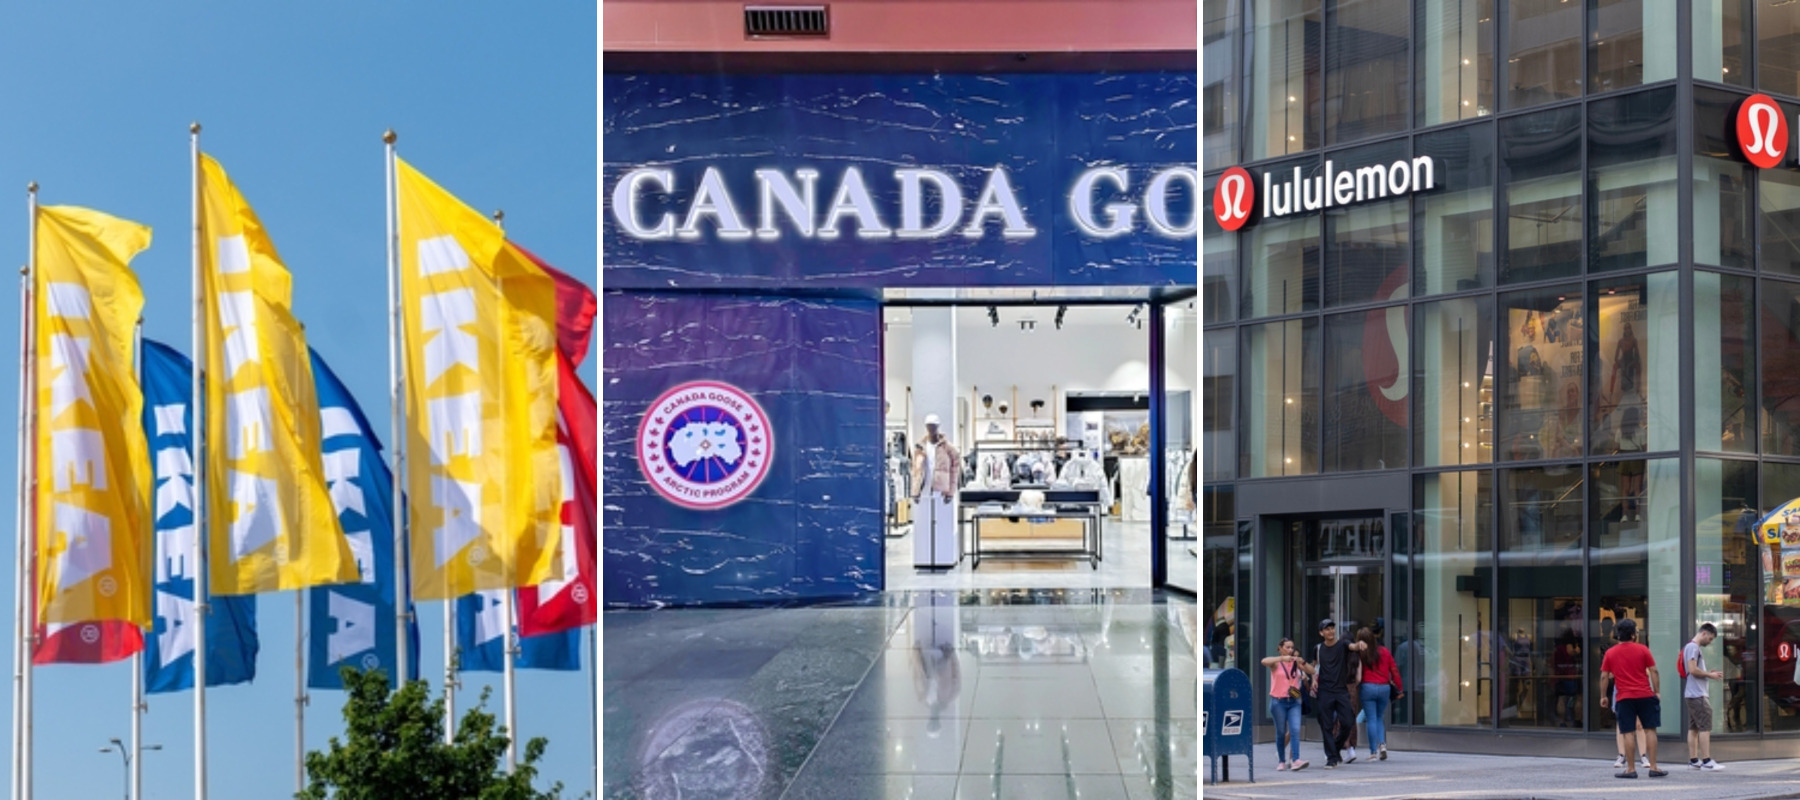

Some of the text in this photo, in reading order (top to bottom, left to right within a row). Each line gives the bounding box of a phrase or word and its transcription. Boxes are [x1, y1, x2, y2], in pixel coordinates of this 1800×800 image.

[612, 166, 1035, 239] CANADA
[1263, 155, 1434, 218] lululemon
[45, 281, 113, 593] IKEA
[217, 234, 285, 566] IKEA
[416, 234, 482, 570] IKEA
[663, 392, 744, 414] CANADA GOOSE
[663, 471, 750, 498] ARCTIC PROGRAM
[153, 403, 196, 669] IKEA
